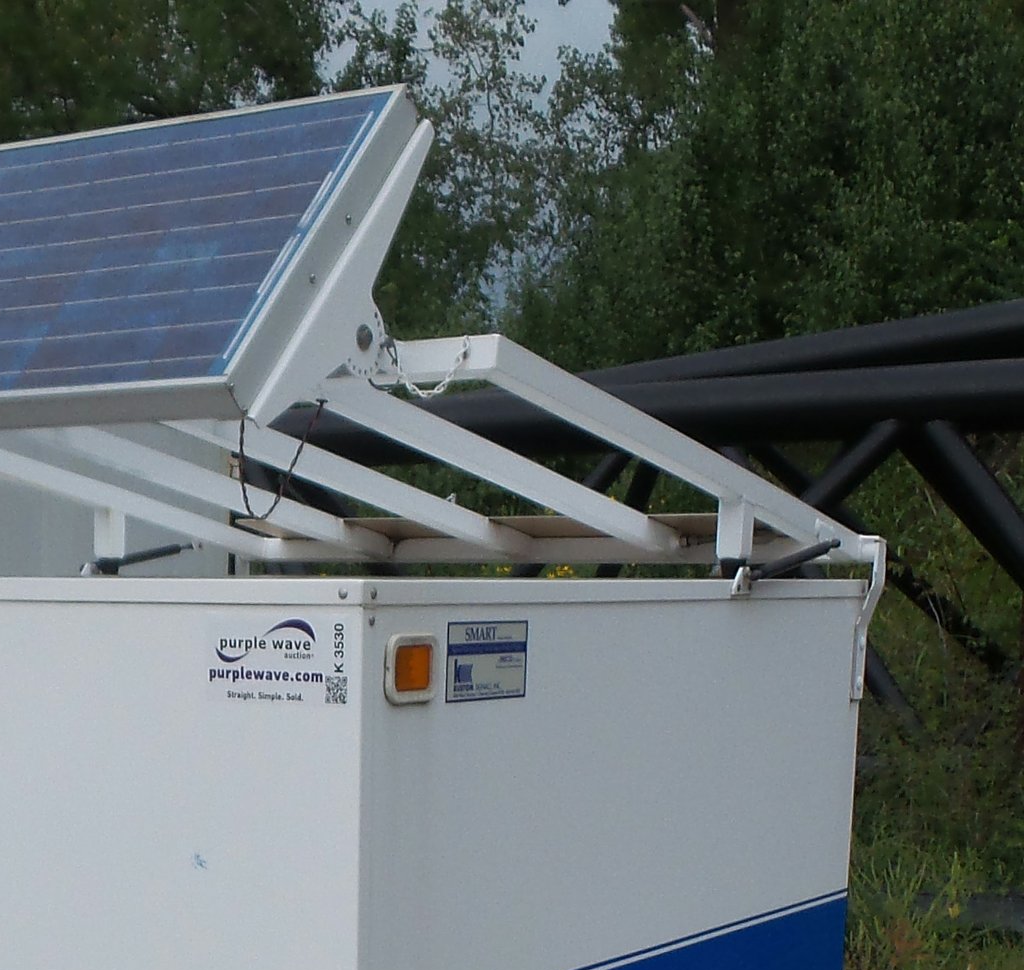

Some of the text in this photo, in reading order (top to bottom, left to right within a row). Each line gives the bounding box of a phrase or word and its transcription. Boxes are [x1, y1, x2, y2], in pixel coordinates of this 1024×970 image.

[465, 626, 497, 641] SMART
[220, 636, 311, 651] purple wave
[334, 623, 344, 673] K 3530
[209, 666, 323, 683] purplewave.com
[227, 690, 304, 702] Straight. Simple. Sold.
